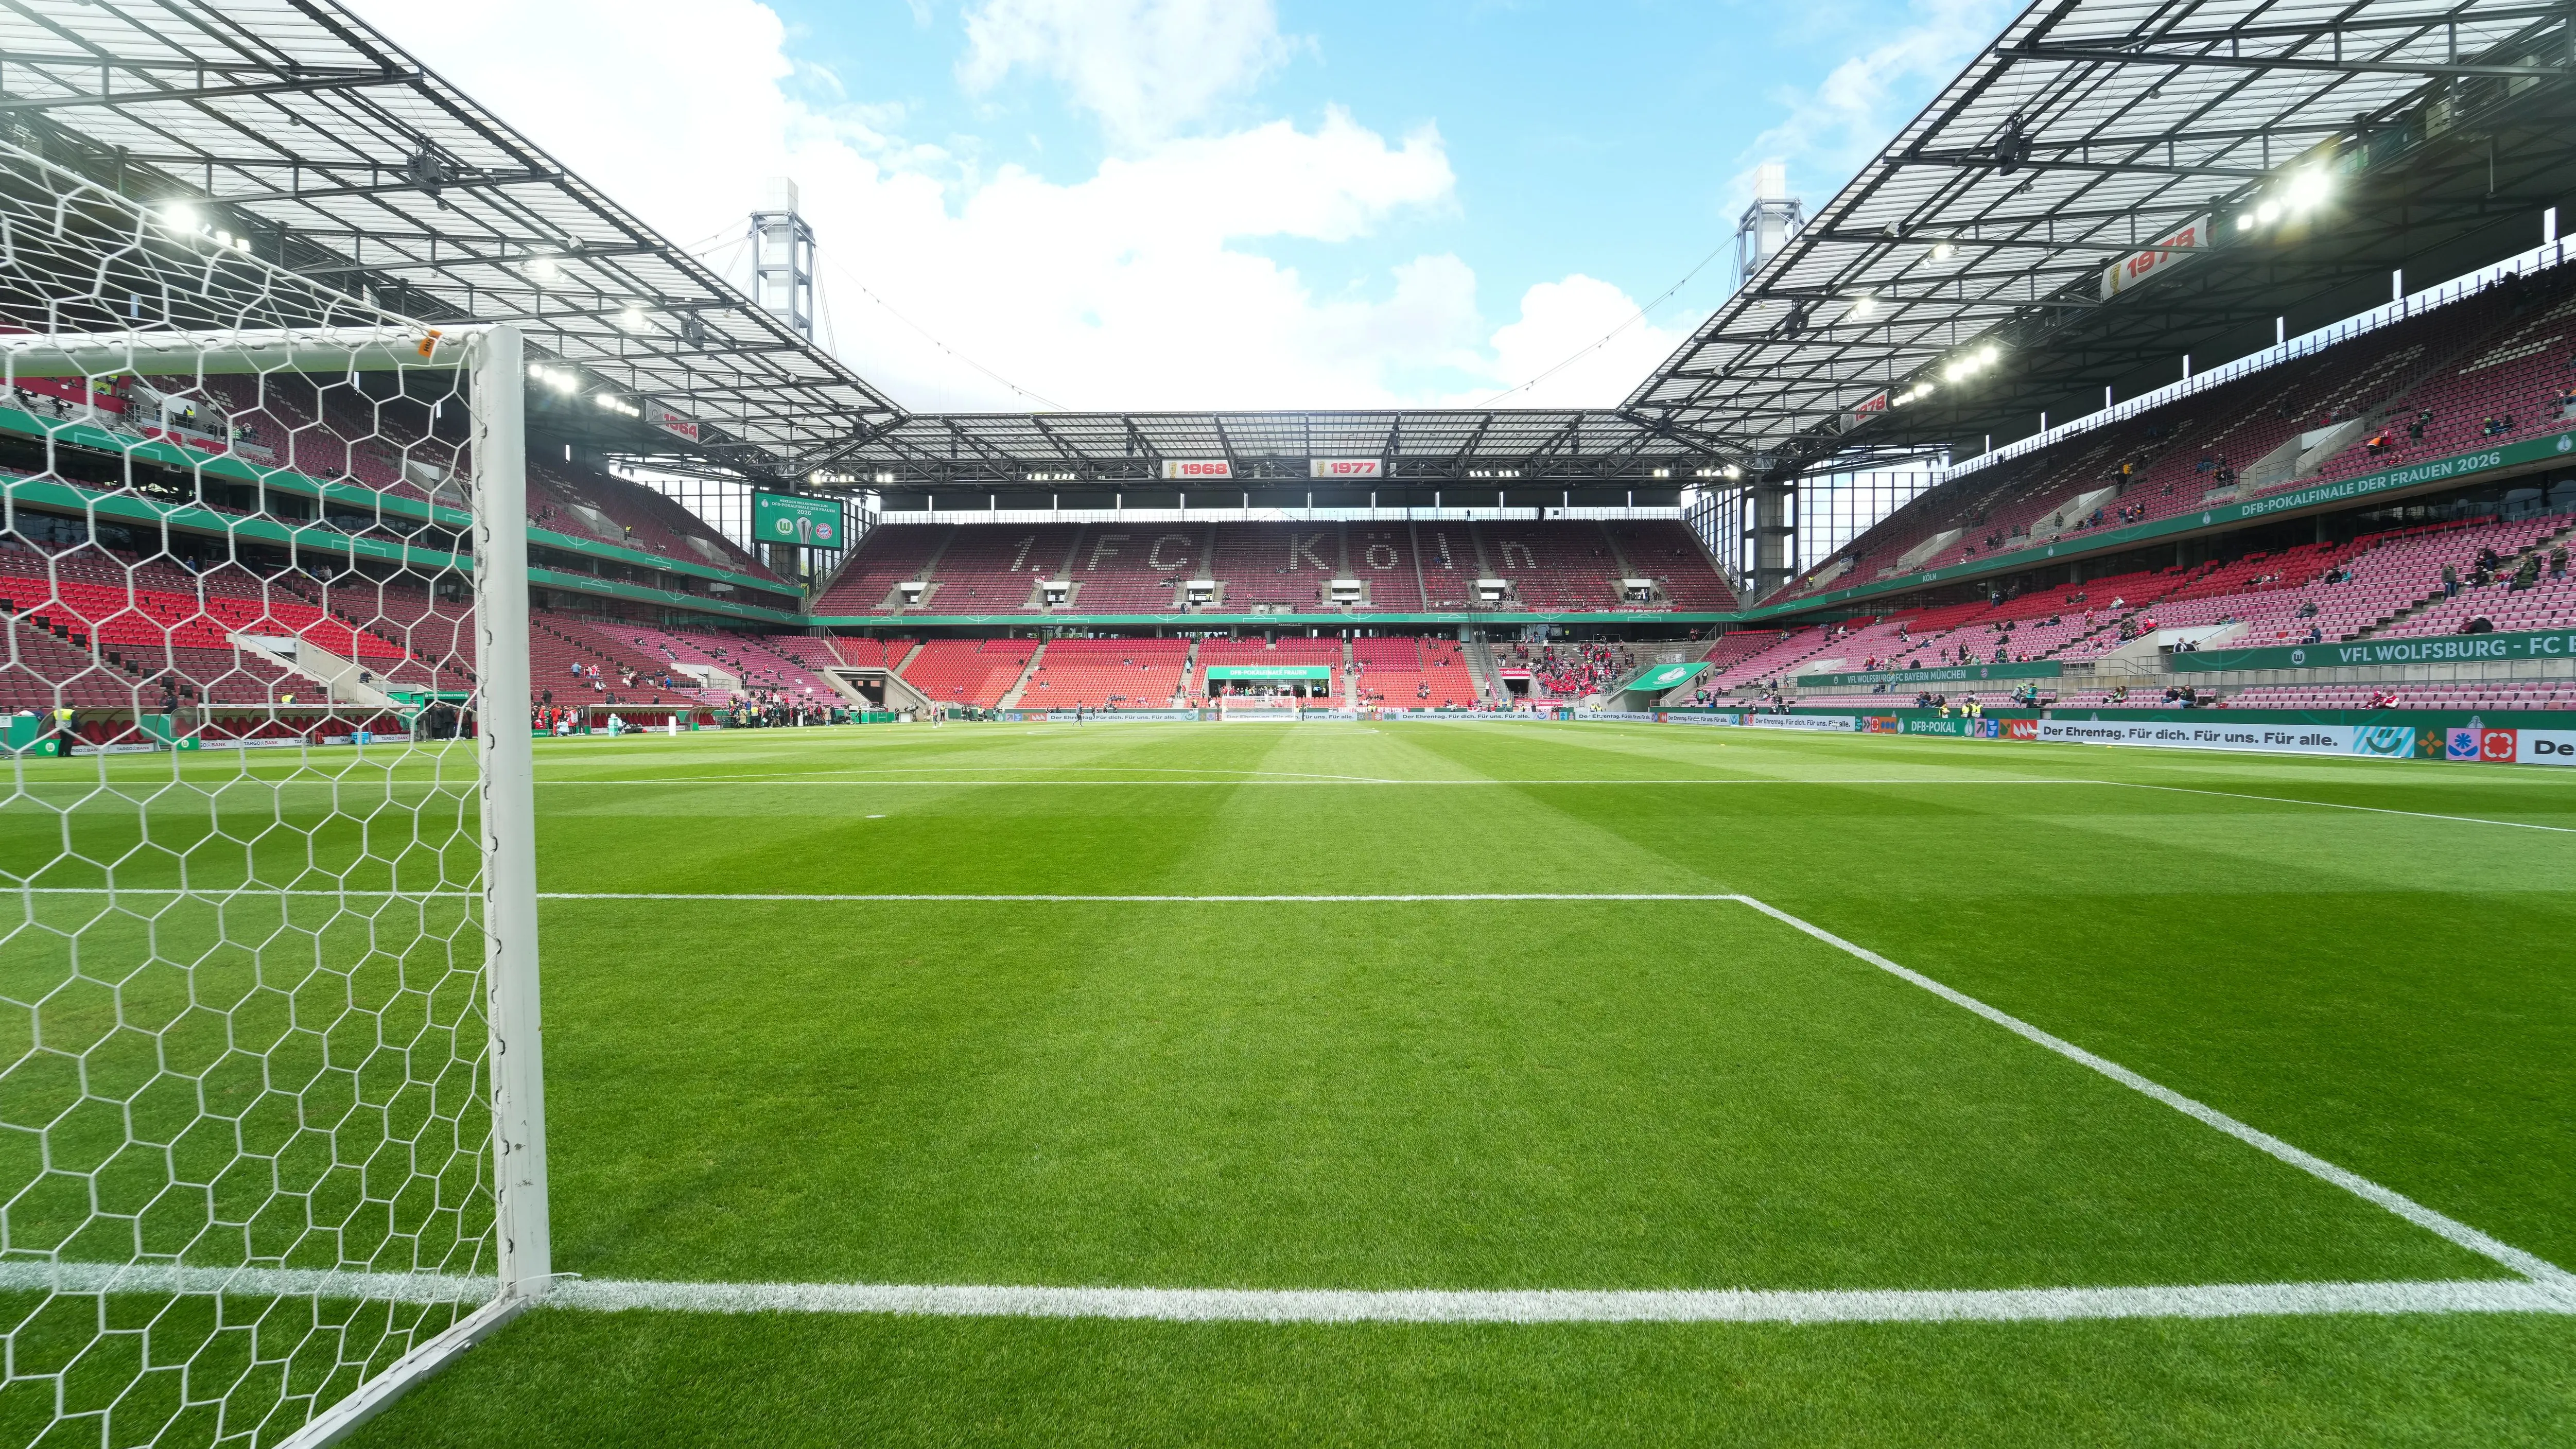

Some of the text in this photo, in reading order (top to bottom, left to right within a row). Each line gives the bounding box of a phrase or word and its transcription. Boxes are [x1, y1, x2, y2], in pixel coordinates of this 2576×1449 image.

[2127, 228, 2195, 278] 1978
[1855, 394, 1885, 421] 1978
[664, 413, 697, 439] 1964
[1181, 463, 1228, 475] 1968
[1331, 462, 1376, 474] 1977
[2242, 451, 2501, 516] DFB-POKALFINALE DER FRAUEN 2026
[1087, 534, 1191, 571] FC
[1290, 533, 1536, 569] Köln
[1923, 572, 1937, 582] KÖLN
[2339, 647, 2372, 662] VFL
[2375, 639, 2506, 660] WOLFSBURG
[2530, 636, 2561, 654] FC
[1857, 674, 1890, 683] WOLFSBURG
[1905, 672, 1928, 681] BAYERN
[1931, 669, 1966, 679] MÜNCHEN
[1911, 721, 1956, 733] DFB-POKAL
[2044, 726, 2338, 746] Der Ehrentag. Für dich. Für uns. Für alle.
[2535, 740, 2576, 756] De
